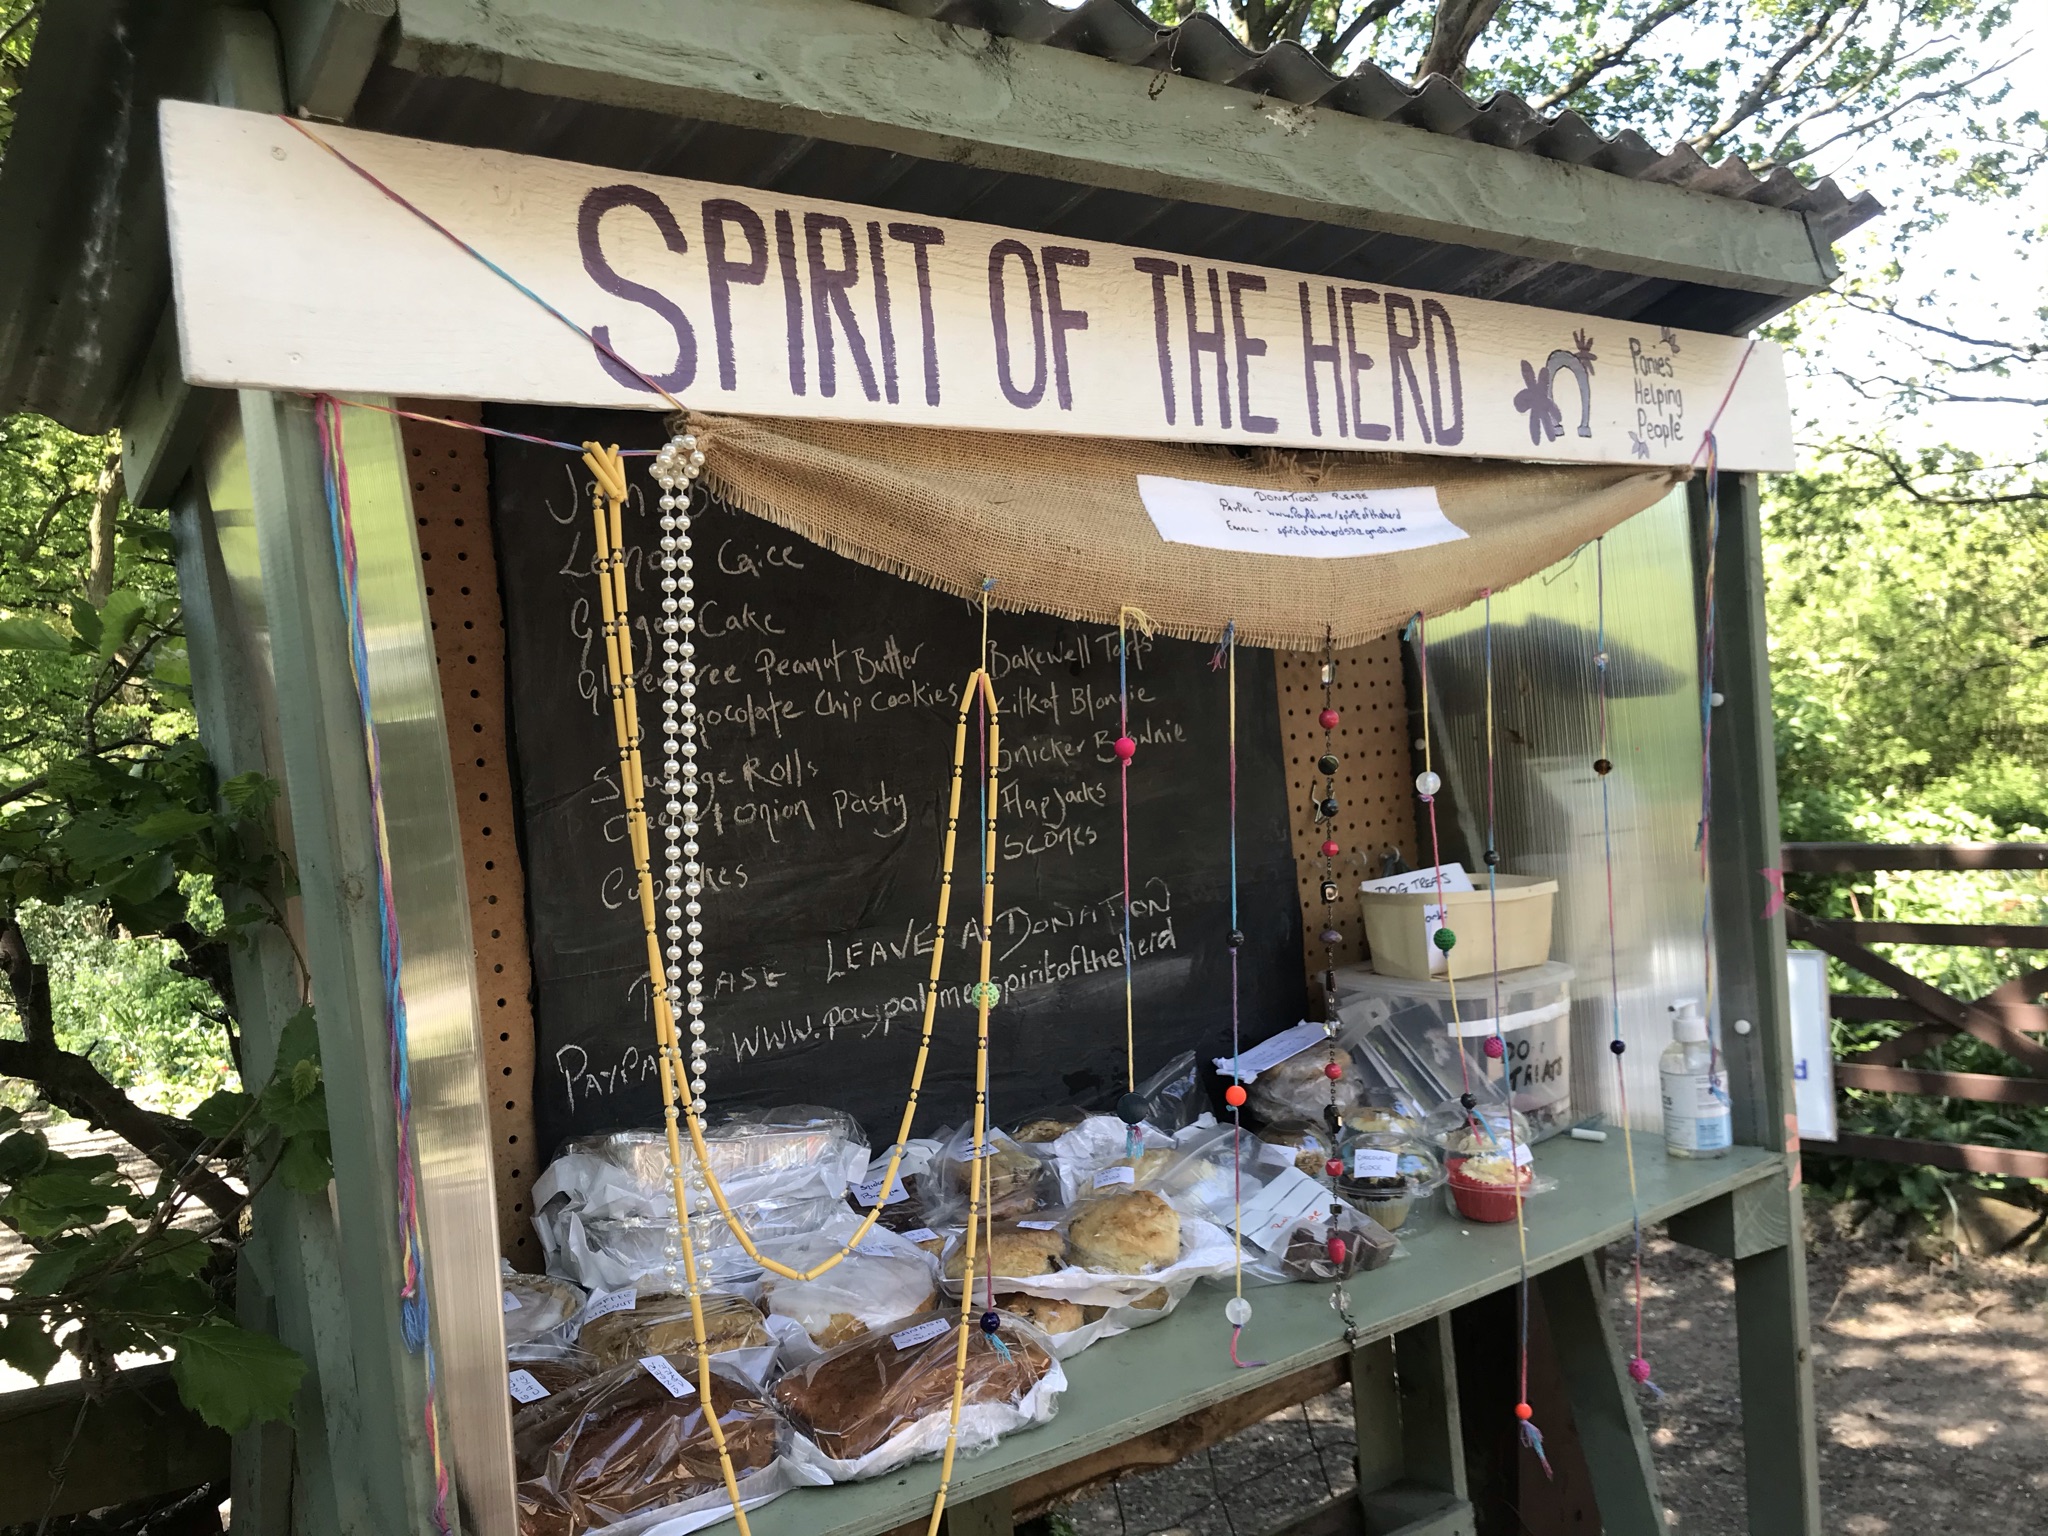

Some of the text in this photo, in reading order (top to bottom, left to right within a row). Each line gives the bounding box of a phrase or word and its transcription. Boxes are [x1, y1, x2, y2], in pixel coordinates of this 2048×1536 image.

[577, 184, 1464, 446] SPIRIT OF THE HERD
[1628, 337, 1674, 378] Ponies
[1634, 378, 1683, 418] Helping
[1637, 408, 1684, 447] People
[698, 600, 785, 638] Cake
[755, 638, 848, 685] Peanut
[853, 634, 924, 684] Butter
[986, 634, 1091, 681] Bakewell
[814, 689, 862, 723] Chip
[871, 679, 959, 712] Cookies
[742, 748, 820, 792] Rolls
[733, 799, 816, 843] Onion
[832, 780, 909, 838] Pasty
[826, 917, 936, 983] LEAVE
[961, 917, 984, 950] A
